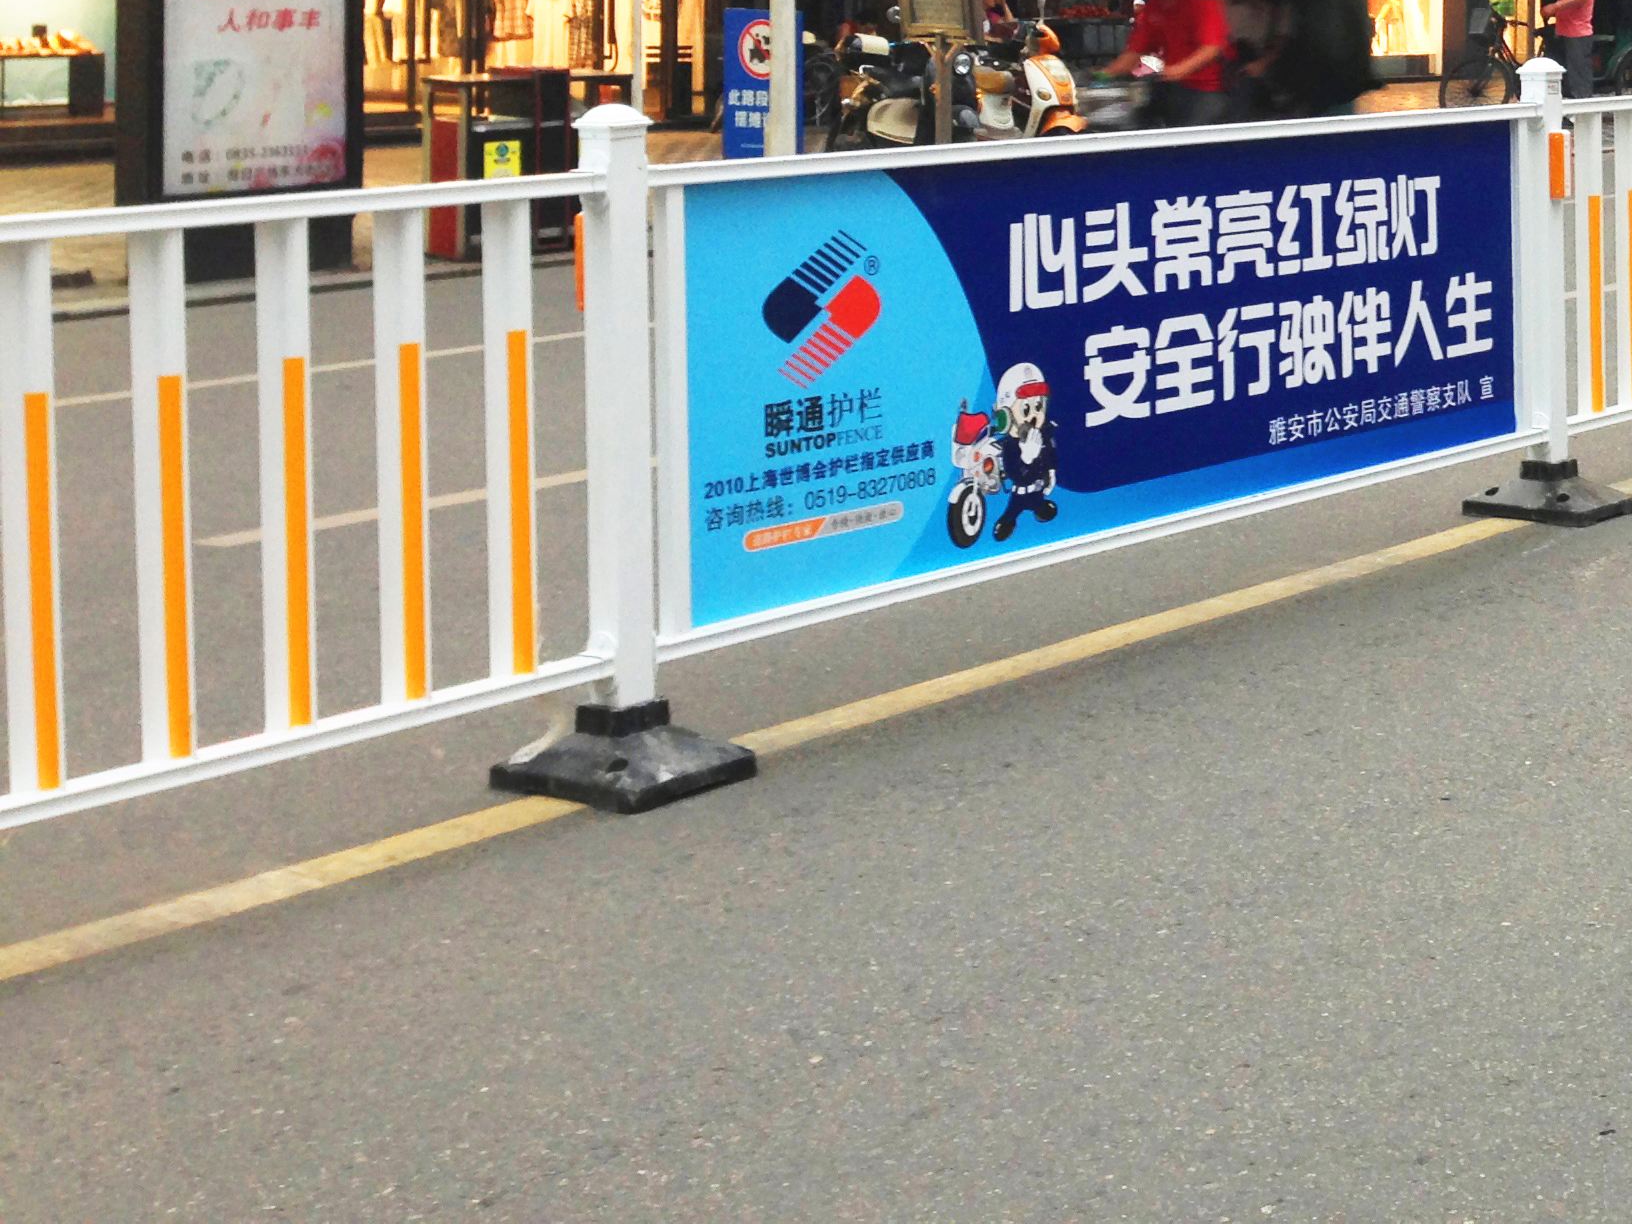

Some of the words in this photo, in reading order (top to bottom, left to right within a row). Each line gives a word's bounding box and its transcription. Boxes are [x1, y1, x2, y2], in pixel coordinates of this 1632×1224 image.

[1007, 173, 1442, 314] 心头常亮红绿灯
[1082, 271, 1496, 429] 安全行驶伴人生
[763, 386, 883, 439] 瞬通护栏
[1268, 379, 1472, 446] 雅安市公安局交通警察支队
[1478, 375, 1495, 401] 宣
[803, 467, 937, 511] 0519-83270808
